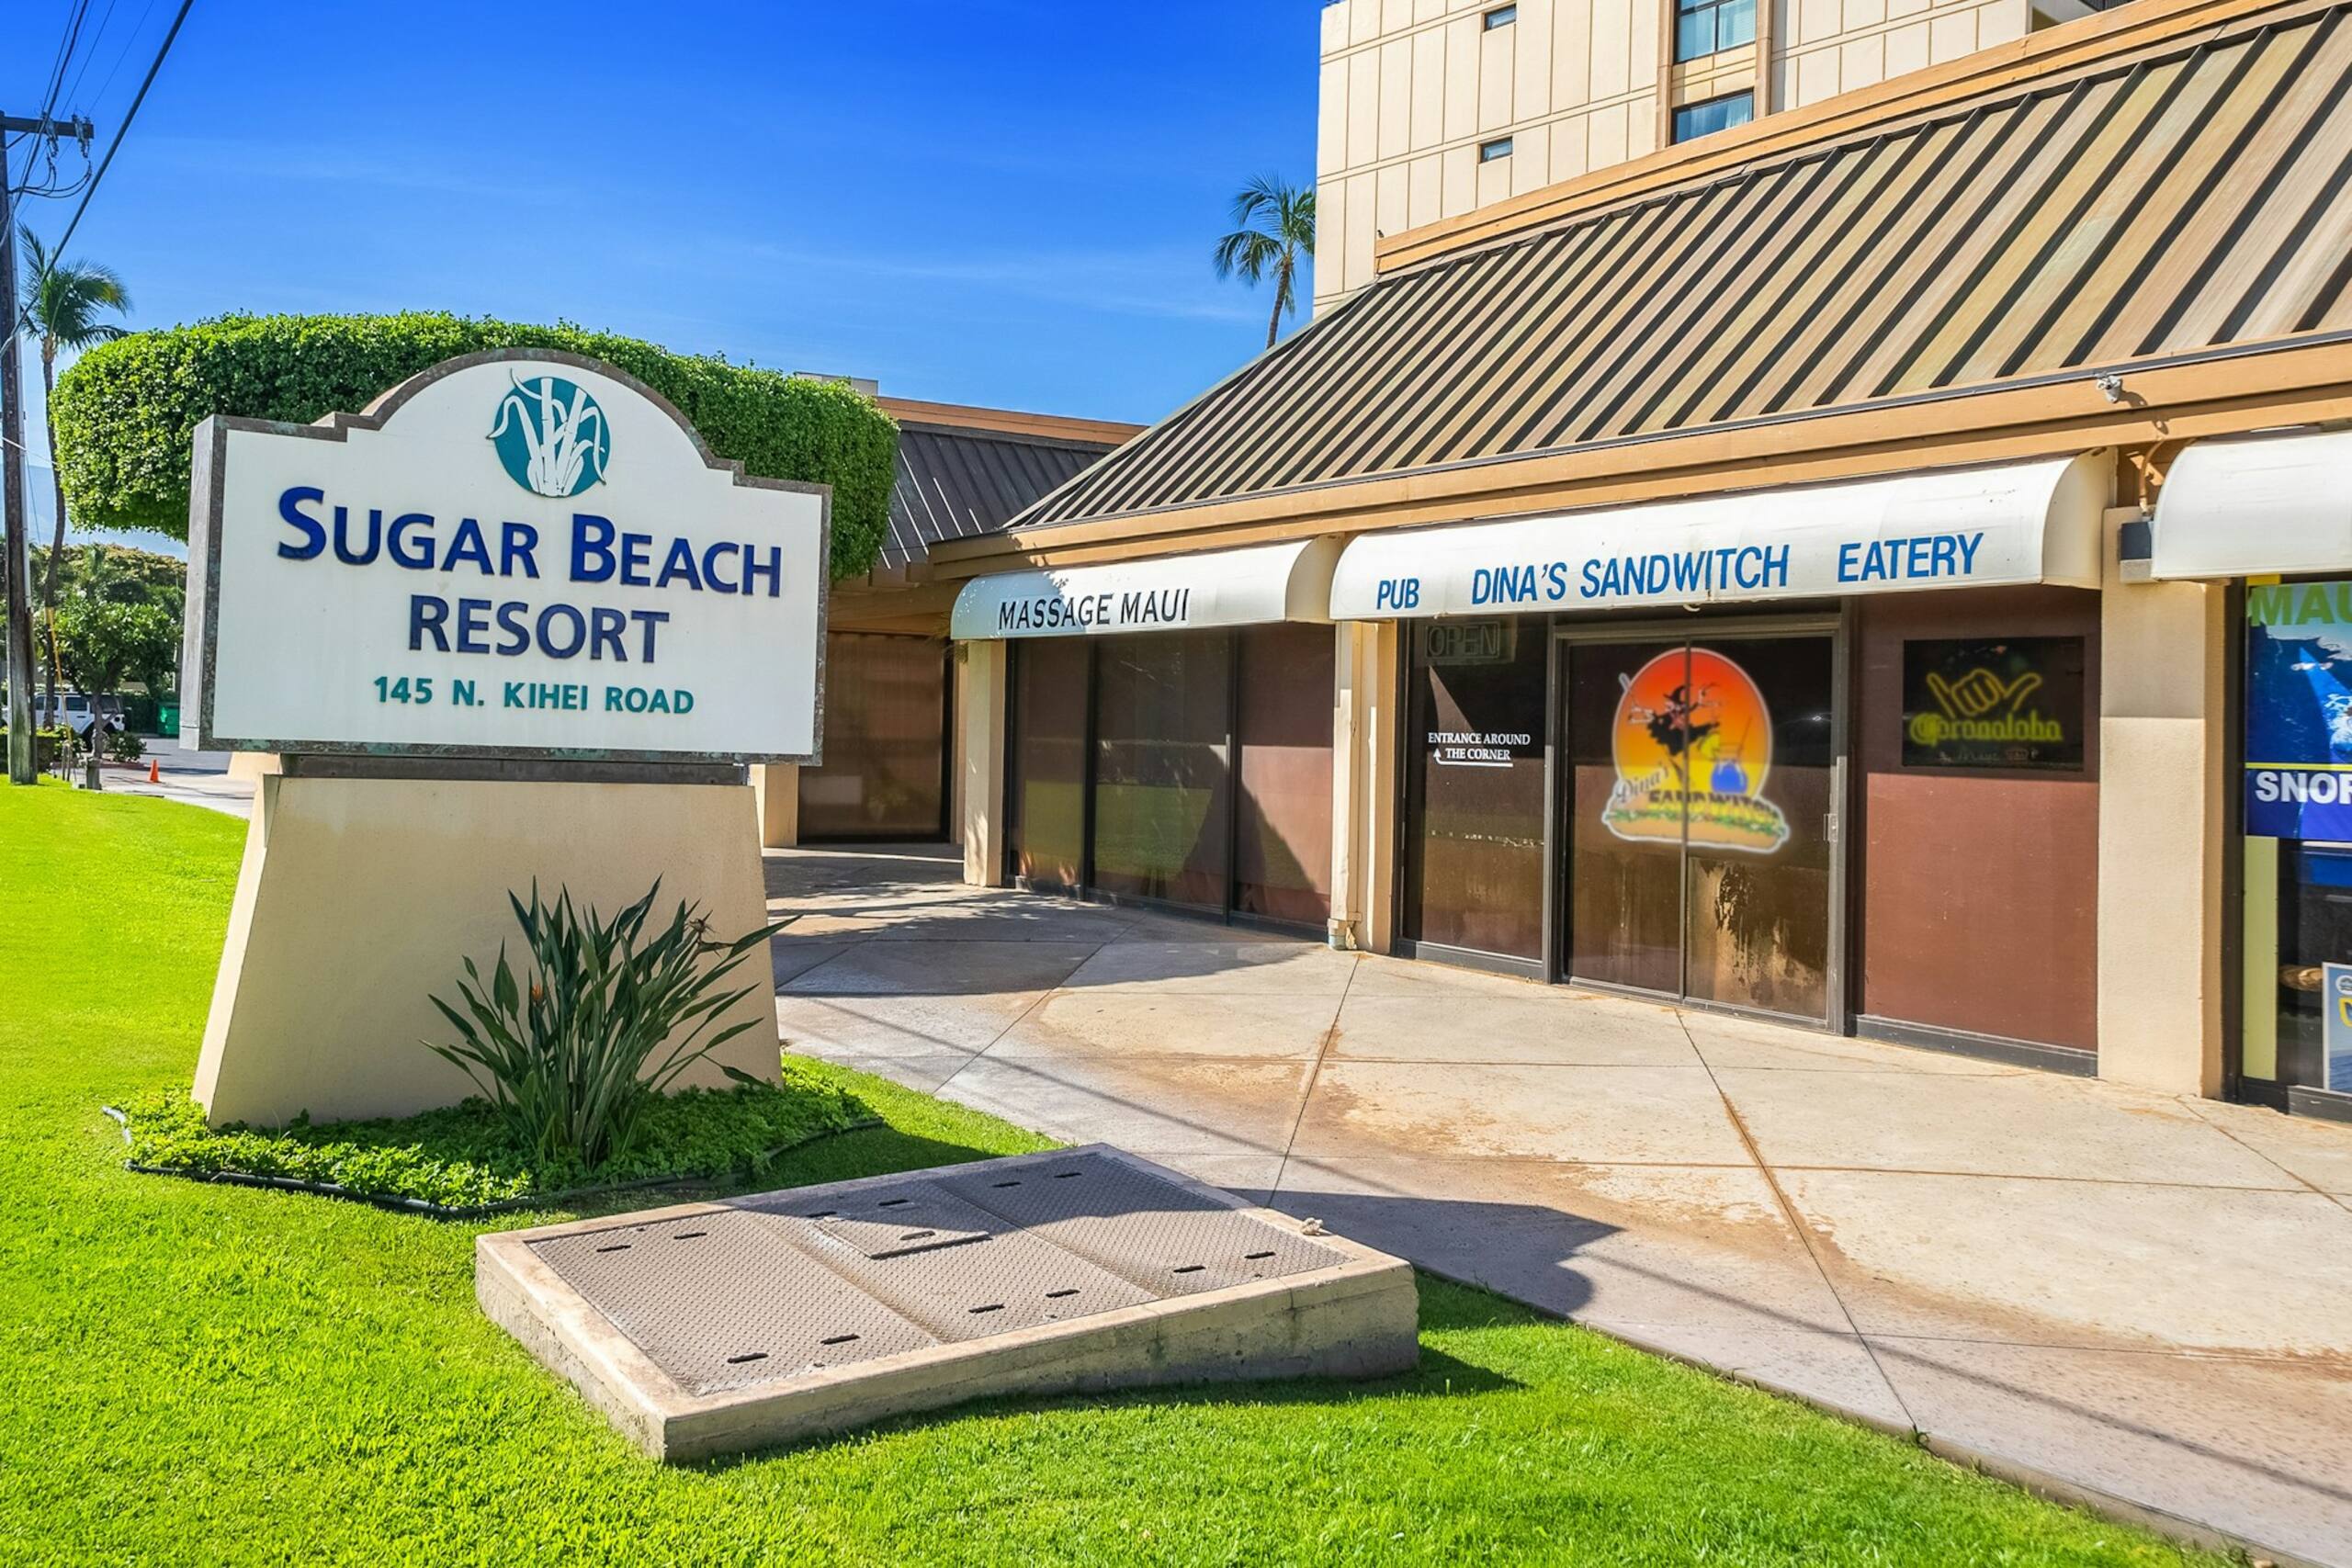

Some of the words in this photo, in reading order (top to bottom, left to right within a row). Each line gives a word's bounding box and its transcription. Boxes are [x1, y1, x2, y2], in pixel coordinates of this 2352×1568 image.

[277, 487, 540, 579] SUGAR
[570, 513, 781, 597] BEACH
[1377, 579, 1419, 609] PUB
[1472, 562, 1566, 604] DINA'S
[1580, 545, 1789, 598] SANDWITCH
[1838, 533, 1983, 582] EATERY
[409, 594, 669, 663] RESORT
[998, 593, 1113, 630] MASSAGE
[1120, 588, 1189, 625] MAUI
[1429, 626, 1498, 656] OPEN
[374, 676, 432, 704] 145
[453, 680, 484, 706] N.
[504, 682, 588, 711] KIHEI
[605, 687, 694, 714] ROAD
[1428, 732, 1482, 745] ENTRANCE
[1483, 733, 1531, 746] AROUND
[1445, 748, 1465, 760] THE
[1467, 748, 1511, 761] CORNER
